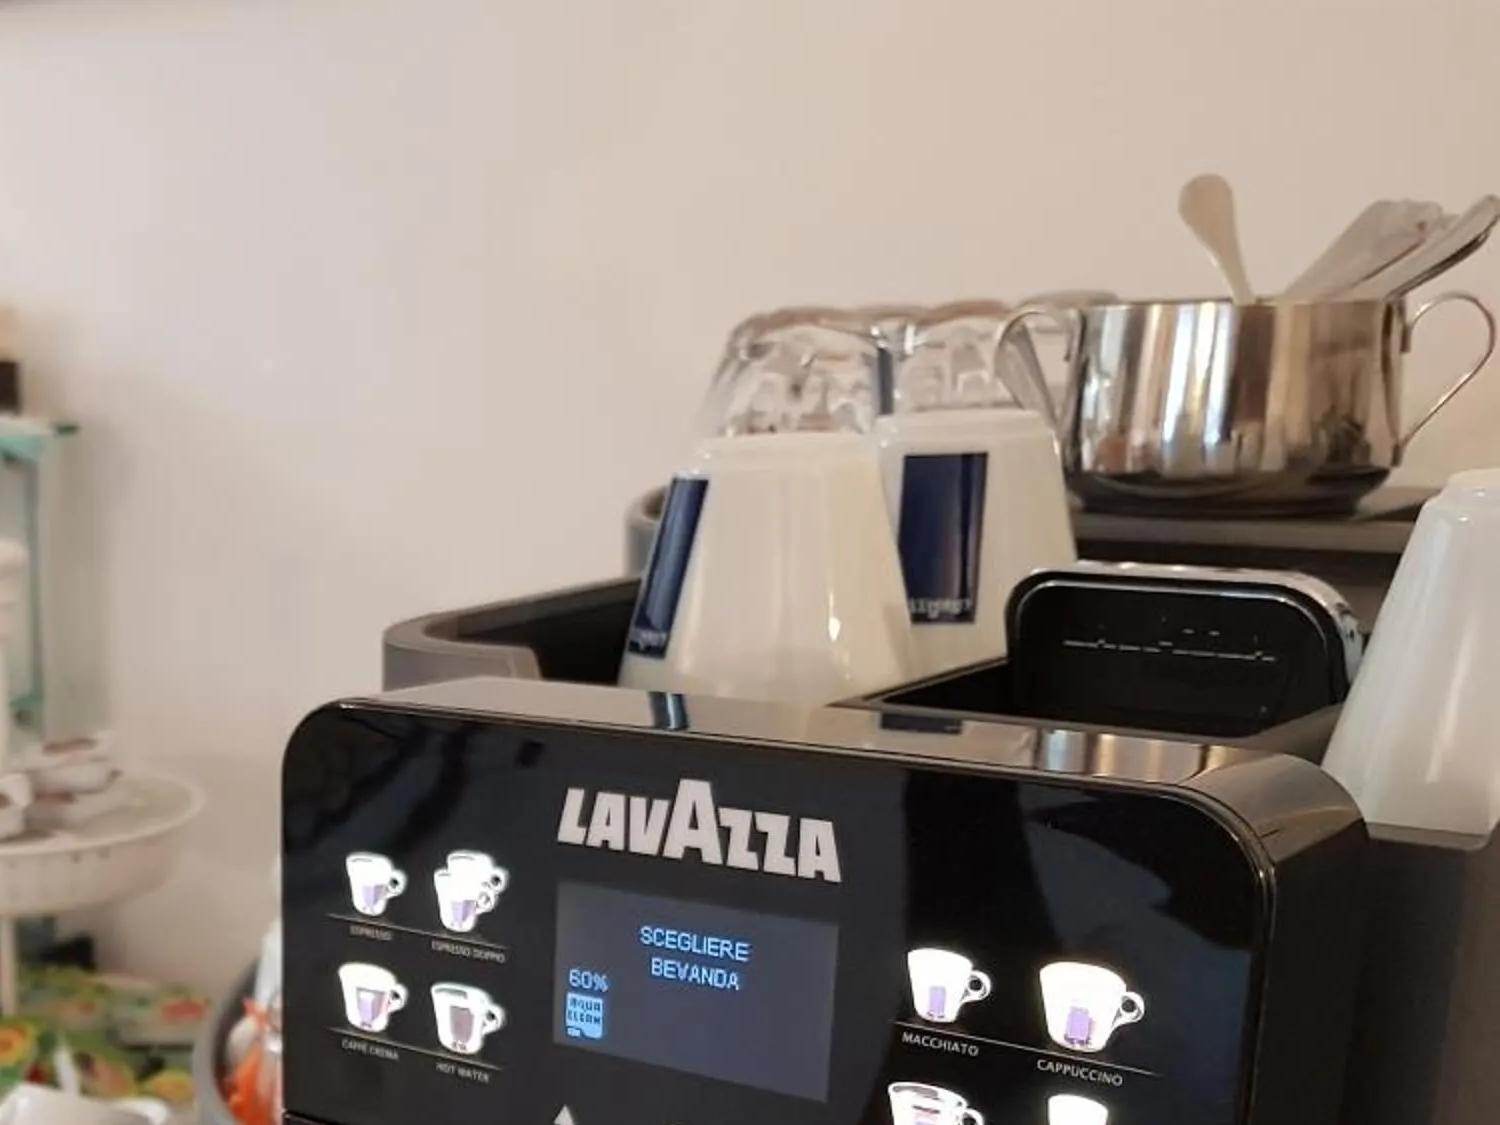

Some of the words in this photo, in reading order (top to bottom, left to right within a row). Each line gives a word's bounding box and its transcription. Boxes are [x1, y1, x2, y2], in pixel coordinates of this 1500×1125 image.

[557, 778, 842, 883] LAVAZZA
[639, 925, 750, 961] SCEGLIERE
[569, 968, 608, 992] 60%
[651, 957, 740, 990] BEVANDA
[902, 1031, 979, 1057] MACCHIATO
[1037, 1059, 1123, 1087] CAPPUCCINO
